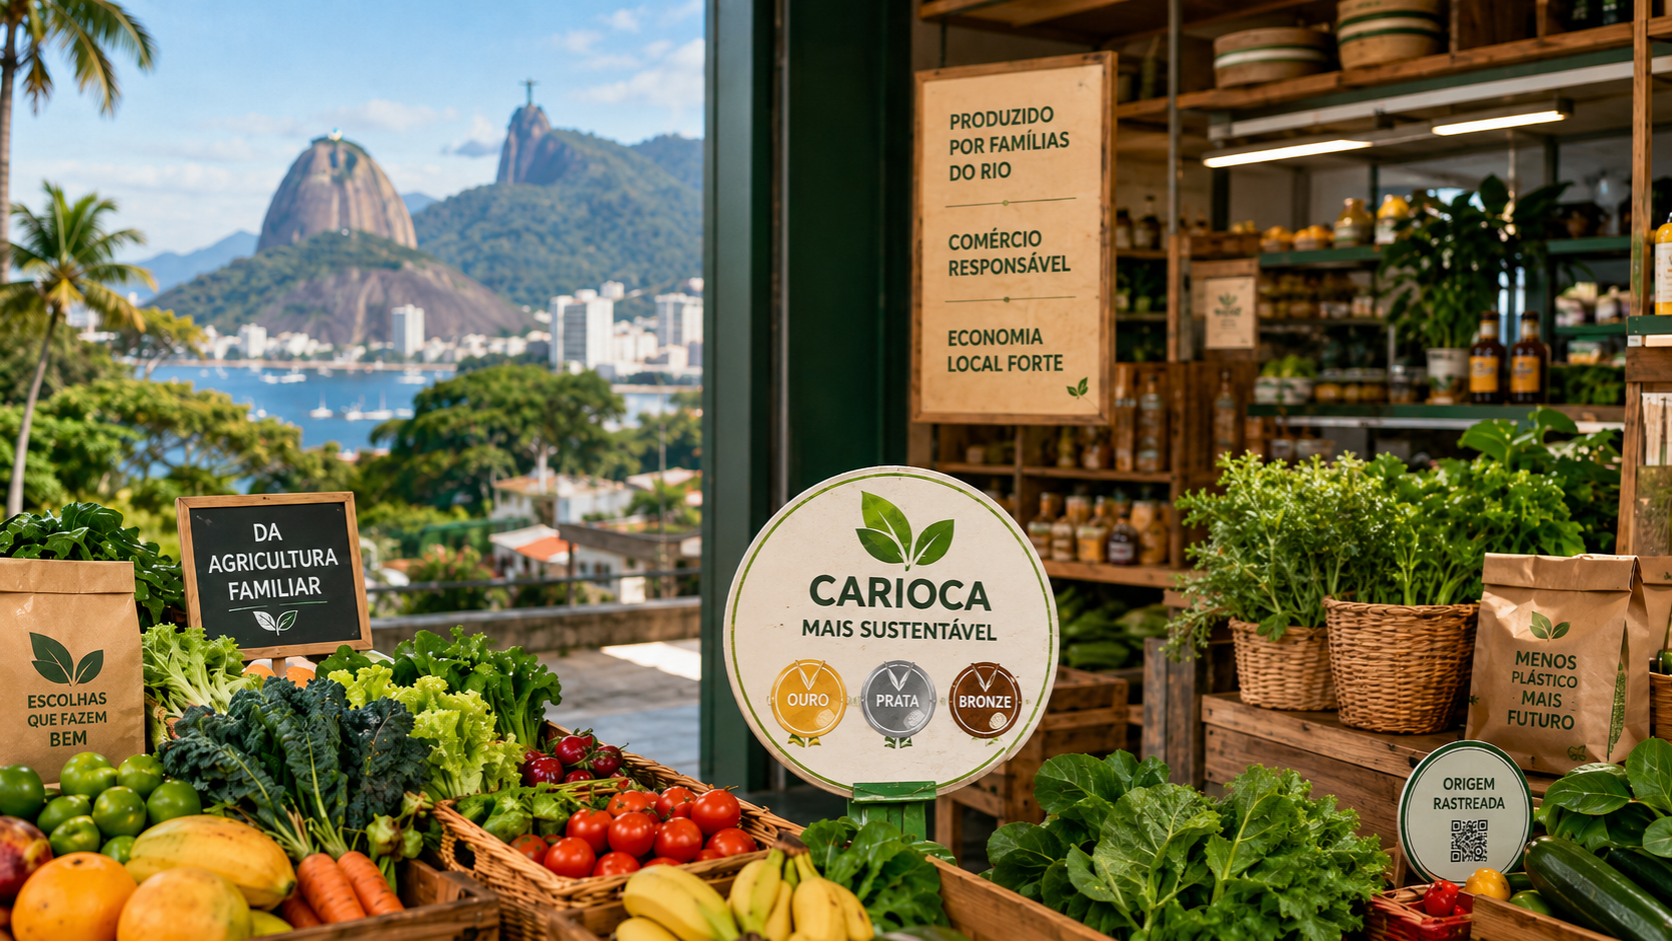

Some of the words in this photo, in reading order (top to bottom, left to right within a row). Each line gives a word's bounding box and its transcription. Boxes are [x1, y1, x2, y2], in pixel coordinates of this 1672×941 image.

[950, 106, 1054, 130] PRODUZIDO
[950, 137, 985, 155] POR
[990, 129, 1069, 153] FAMÍLIAS
[950, 163, 975, 181] DO
[981, 161, 1011, 179] RIO
[948, 228, 1042, 250] COMÉRCIO
[949, 252, 1070, 276] RESPONSÁVEL
[948, 328, 1043, 346] ECONOMIA
[948, 355, 1002, 372] LOCAL
[1008, 355, 1063, 371] FORTE
[253, 522, 282, 542] DA
[209, 548, 338, 573] AGRICULTURA
[229, 576, 322, 601] FAMILIAR
[810, 575, 992, 611] CARIOCA
[802, 619, 853, 637] MAIS
[861, 618, 997, 641] SUSTENTÁVEL
[1515, 650, 1577, 670] MENOS
[1512, 669, 1577, 688] PLÁSTICO
[28, 692, 107, 709] ESCOLHAS
[787, 693, 829, 707] OURO
[876, 694, 919, 708] PRATA
[959, 695, 1011, 709] BRONZE
[1521, 691, 1562, 708] MAIS
[27, 712, 57, 728] QUE
[61, 711, 107, 725] FAZEM
[1507, 709, 1575, 730] FUTURO
[50, 730, 87, 747] BEM
[1443, 777, 1495, 790] ORIGEM
[1433, 797, 1505, 810] RASTREADA
